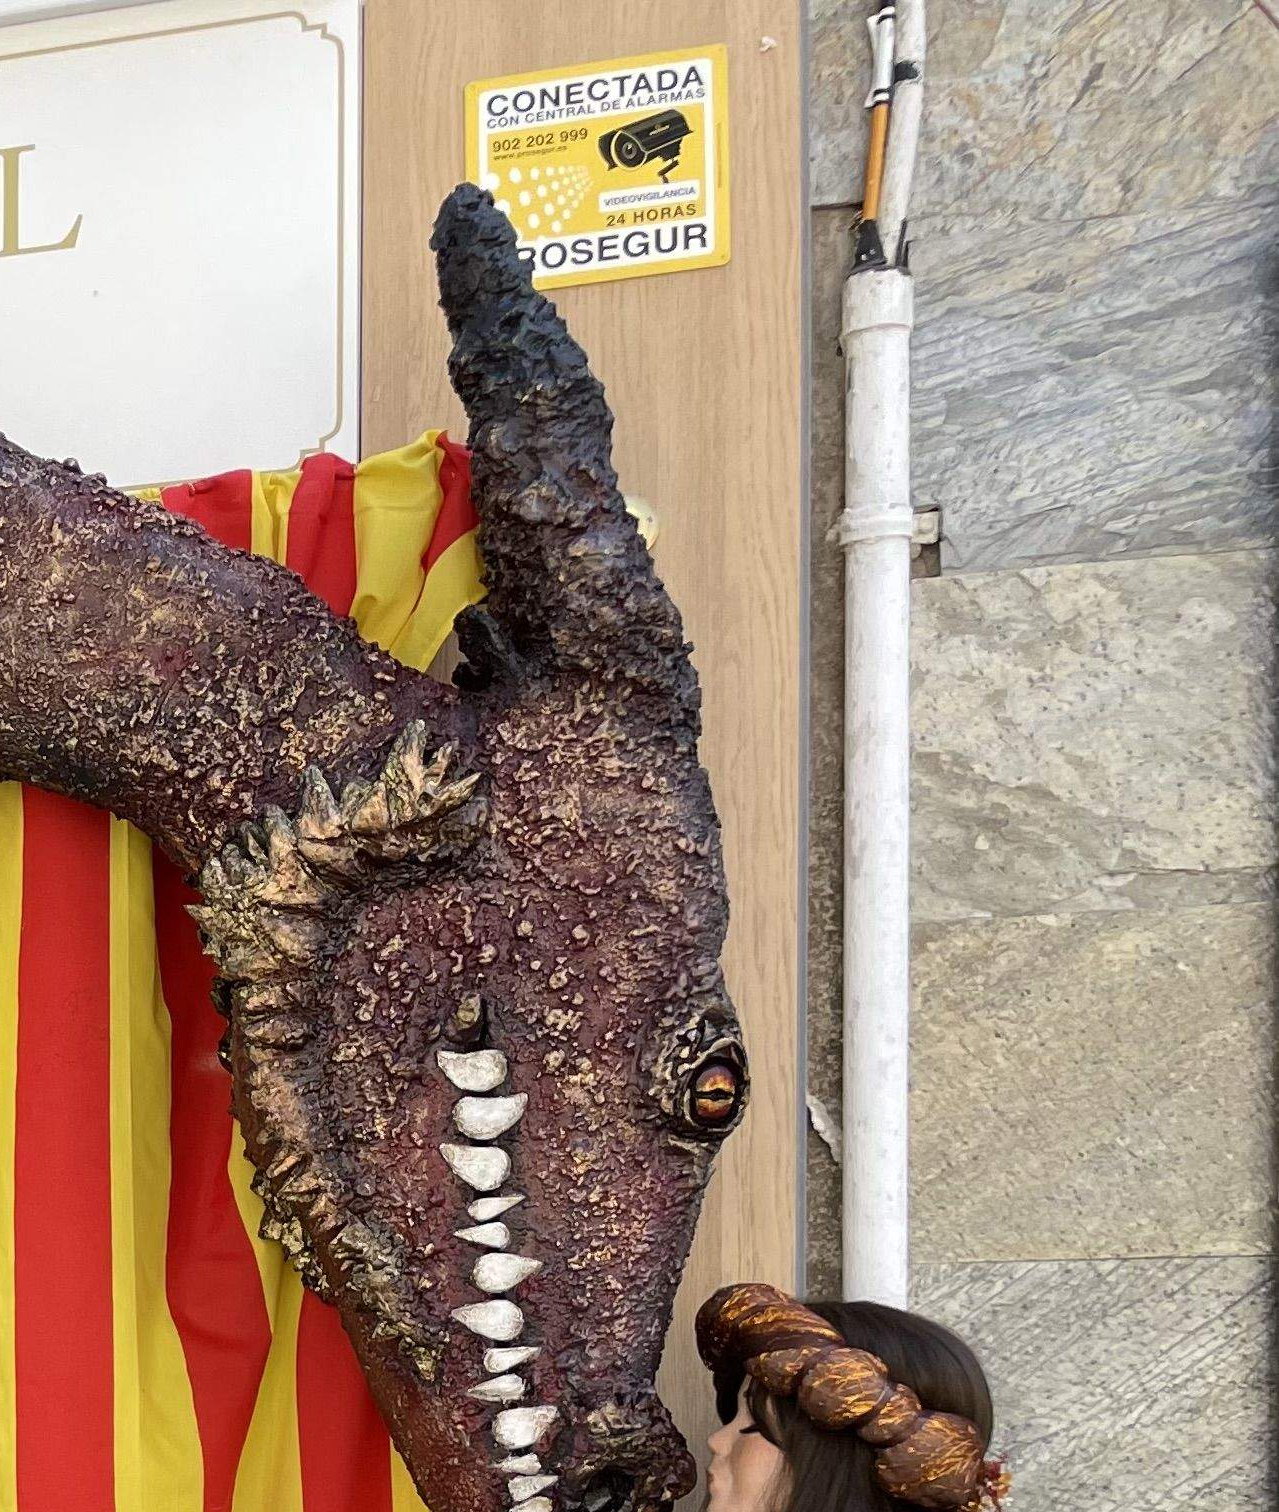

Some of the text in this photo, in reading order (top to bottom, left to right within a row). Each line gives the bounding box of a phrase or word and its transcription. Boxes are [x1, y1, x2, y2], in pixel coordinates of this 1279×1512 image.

[486, 66, 704, 117] CONECTADA
[486, 87, 706, 129] CON CENTRAL DE ALARMAS
[492, 127, 589, 152] 902 202 999
[603, 186, 697, 206] VIDEOVIGILANCIA
[606, 203, 698, 227] 24 HORAS
[517, 223, 708, 270] ROSEGUR
